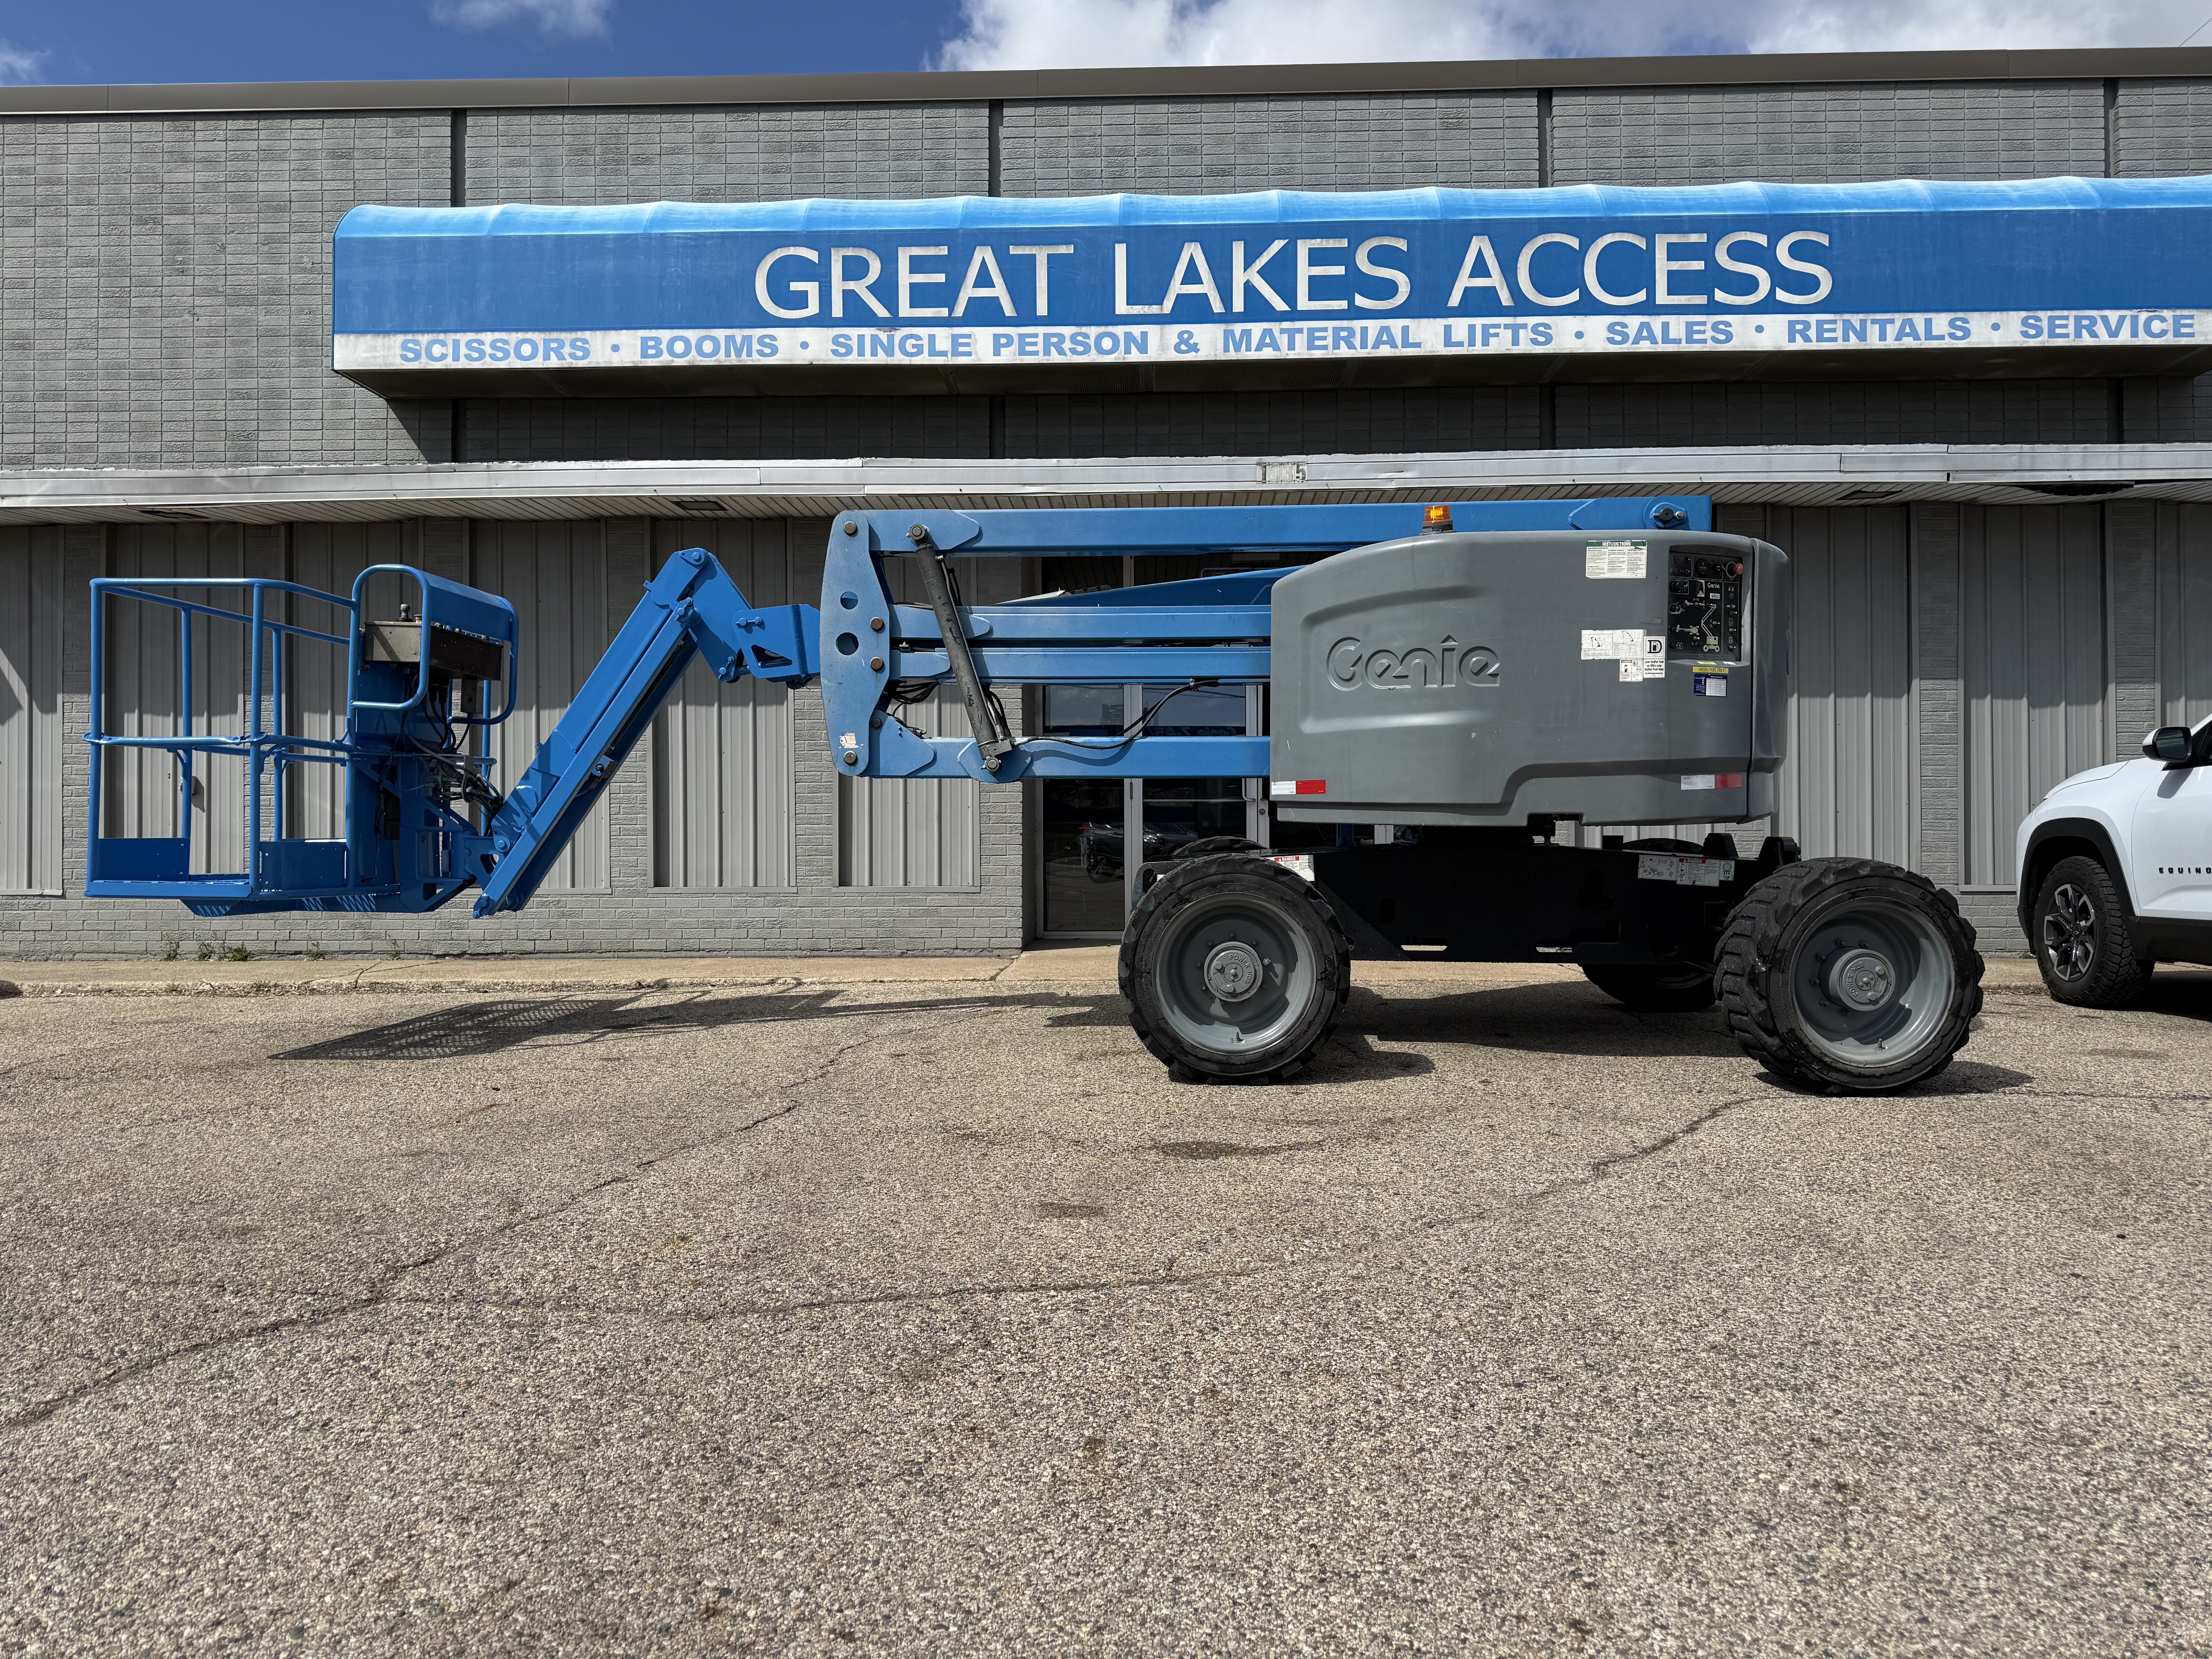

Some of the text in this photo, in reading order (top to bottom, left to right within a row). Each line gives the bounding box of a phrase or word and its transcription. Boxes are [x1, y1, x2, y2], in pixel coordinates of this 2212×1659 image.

[755, 230, 1832, 319] GREAT LAKES ACCESS
[400, 315, 2195, 362] SCISSORS BOOMS SINGLE PERSON & MATERIAL LIFTS SALES RENTALS SERVICE
[1326, 634, 1501, 691] Genie
[1647, 640, 1662, 654] D
[1229, 954, 1250, 969] POWER
[1847, 962, 1865, 998] POWER HUB
